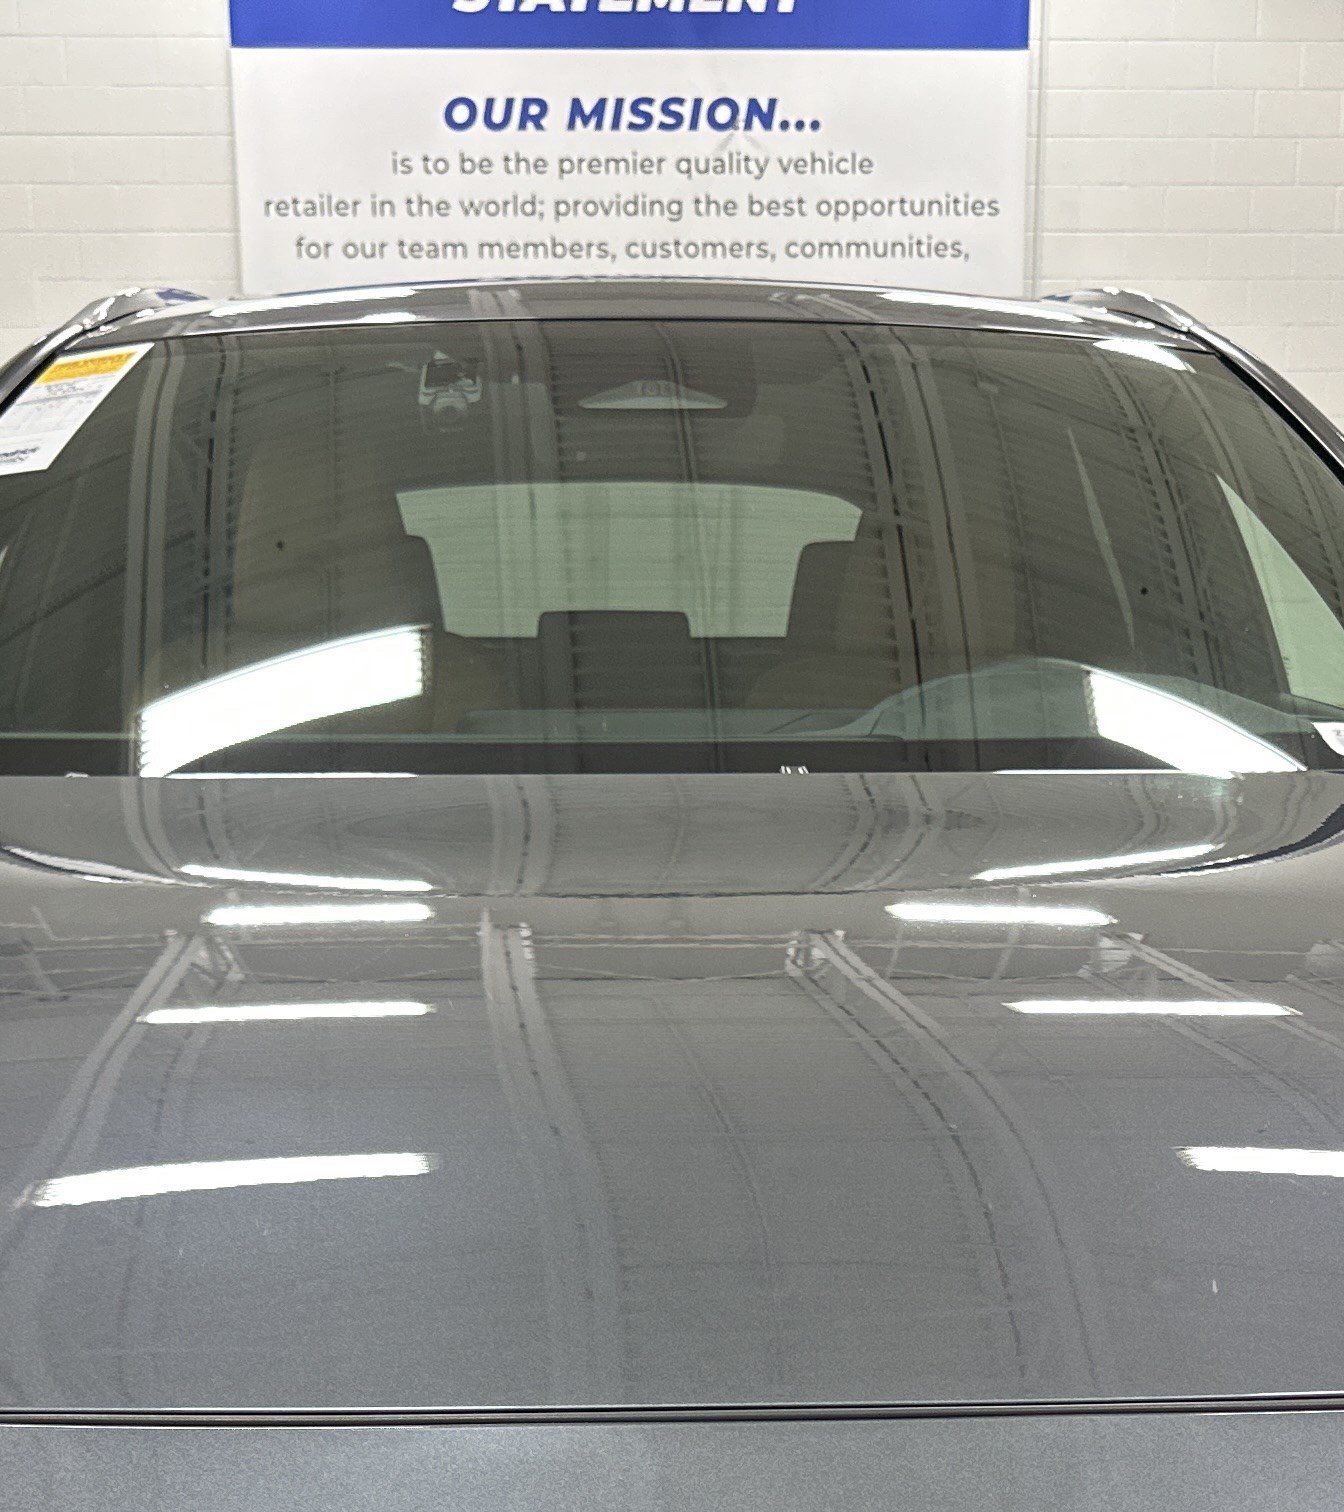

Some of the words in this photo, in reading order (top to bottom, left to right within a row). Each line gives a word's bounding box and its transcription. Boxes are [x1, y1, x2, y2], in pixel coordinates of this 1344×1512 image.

[444, 96, 549, 132] OUR
[566, 96, 821, 132] MISSION...
[391, 151, 414, 175] is
[420, 153, 450, 175] to
[458, 151, 494, 176] be
[502, 151, 550, 175] the
[558, 151, 667, 180] premier
[674, 151, 770, 181] quality
[777, 151, 874, 176] vehicle
[263, 193, 362, 218] retailer
[370, 193, 396, 218] in
[404, 194, 452, 218] the
[458, 193, 545, 221] world;
[553, 192, 684, 223] providing
[692, 193, 738, 217] the
[747, 193, 808, 218] best
[815, 193, 1001, 223] opportunities
[295, 235, 334, 259] for
[341, 239, 388, 260] our
[397, 238, 468, 260] team
[477, 235, 617, 263] members,
[624, 237, 777, 262] customers,
[784, 235, 970, 263] communities,
